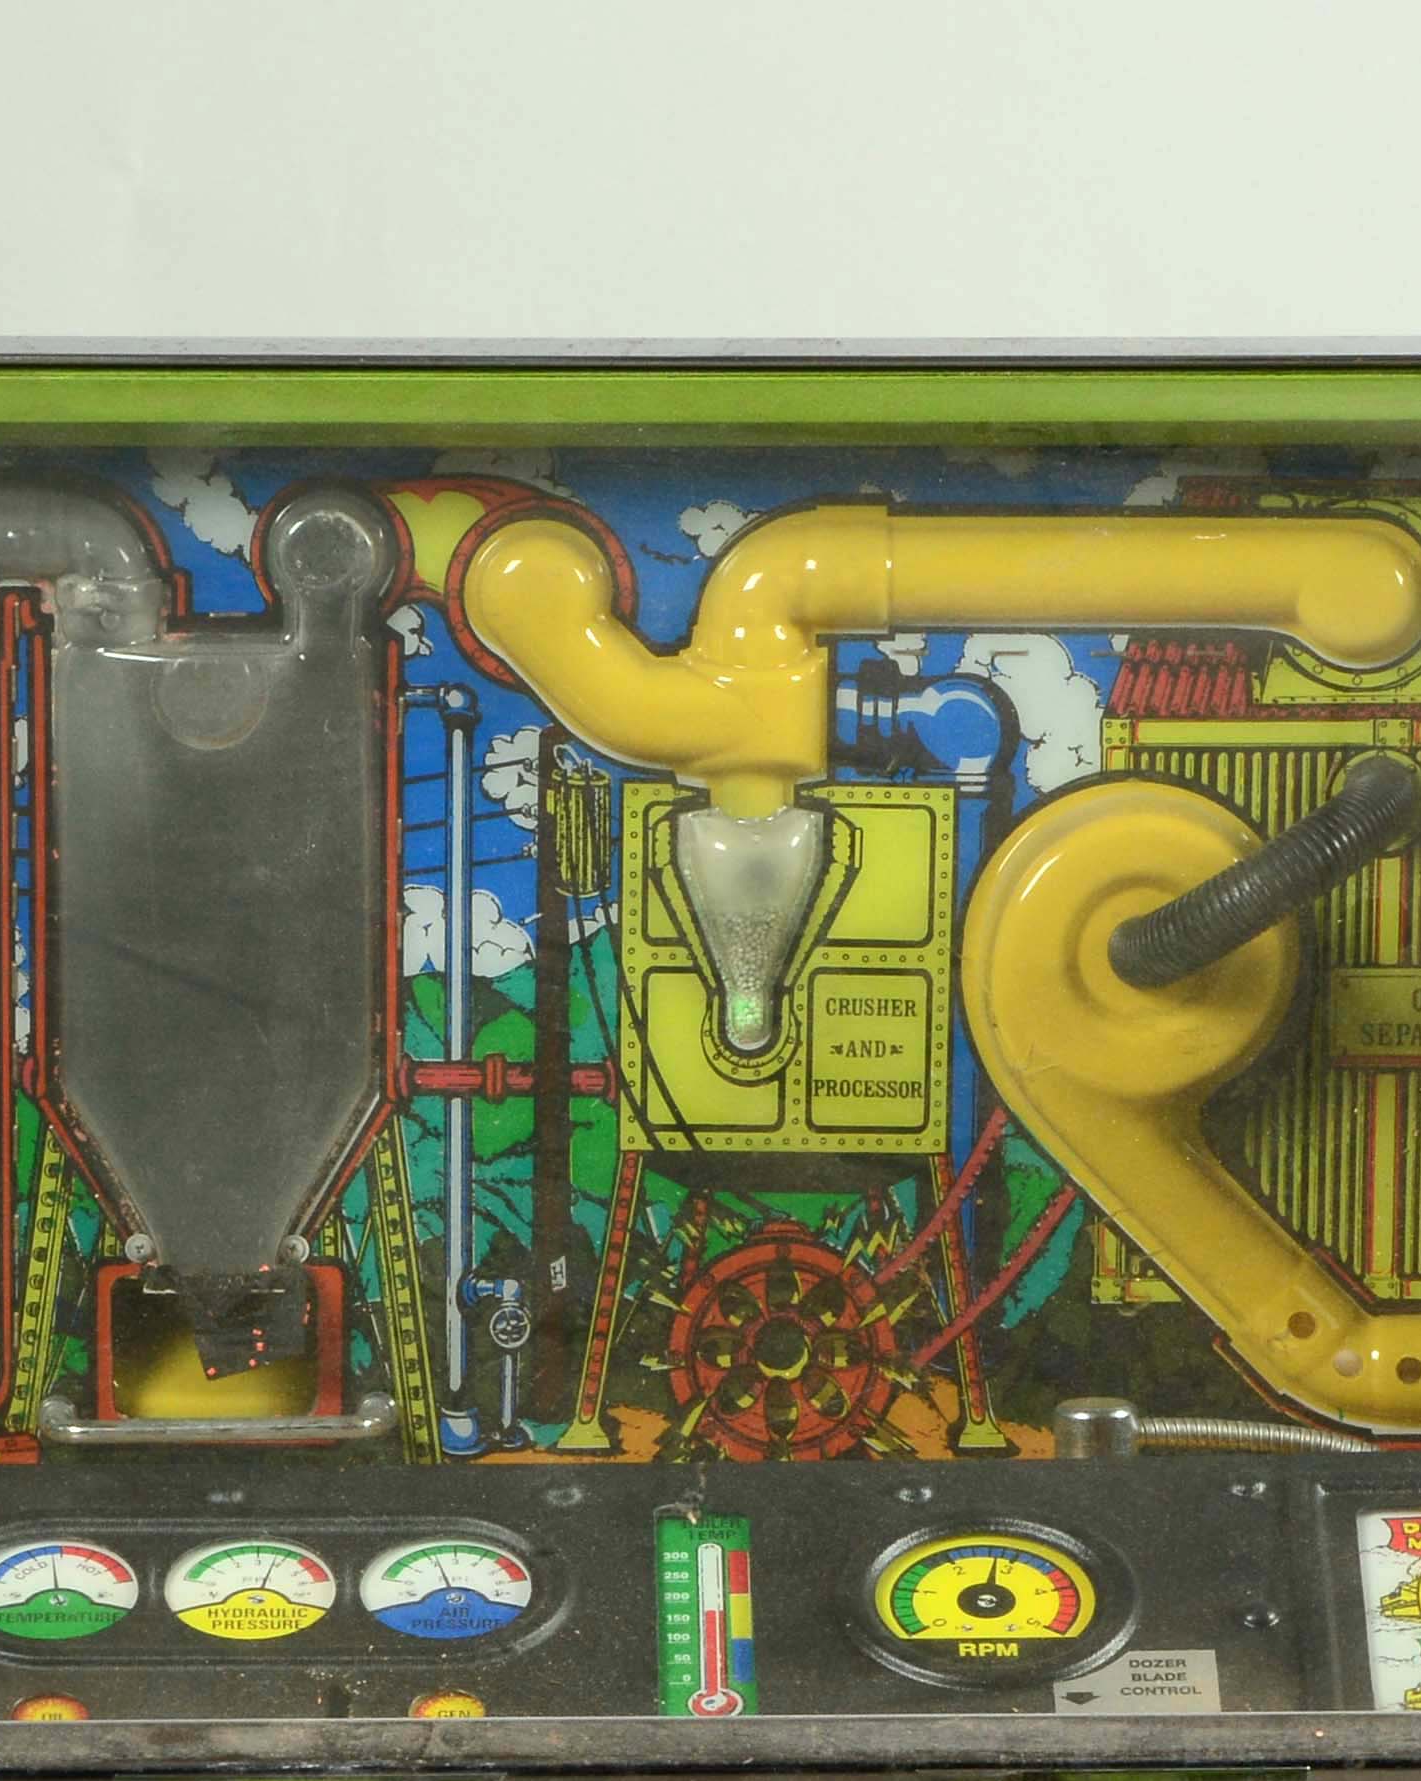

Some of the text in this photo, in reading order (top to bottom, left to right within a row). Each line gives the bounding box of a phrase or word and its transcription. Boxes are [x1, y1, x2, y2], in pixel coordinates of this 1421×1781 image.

[825, 998, 917, 1017] CRUSHER
[845, 1039, 887, 1058] AND
[813, 1079, 923, 1099] PROCESSOR
[663, 1552, 689, 1560] 300
[16, 1561, 48, 1581] COLD
[76, 1562, 103, 1578] HOT
[953, 1566, 967, 1576] 2
[1000, 1565, 1014, 1575] 3
[664, 1571, 689, 1580] 250
[664, 1592, 690, 1600] 200
[207, 1607, 308, 1619] HYDRAULIC
[439, 1607, 469, 1618] AIR
[666, 1614, 690, 1622] 150
[932, 1618, 947, 1627] 0
[211, 1619, 305, 1631] PRESSURE
[412, 1619, 504, 1630] PRESSURE
[666, 1633, 690, 1641] 100
[959, 1643, 1018, 1657] RPM
[674, 1653, 691, 1662] 50
[1130, 1659, 1187, 1668] DOZER
[683, 1673, 691, 1682] 0
[1131, 1672, 1187, 1682] BLADE
[1120, 1685, 1203, 1696] CONTROL
